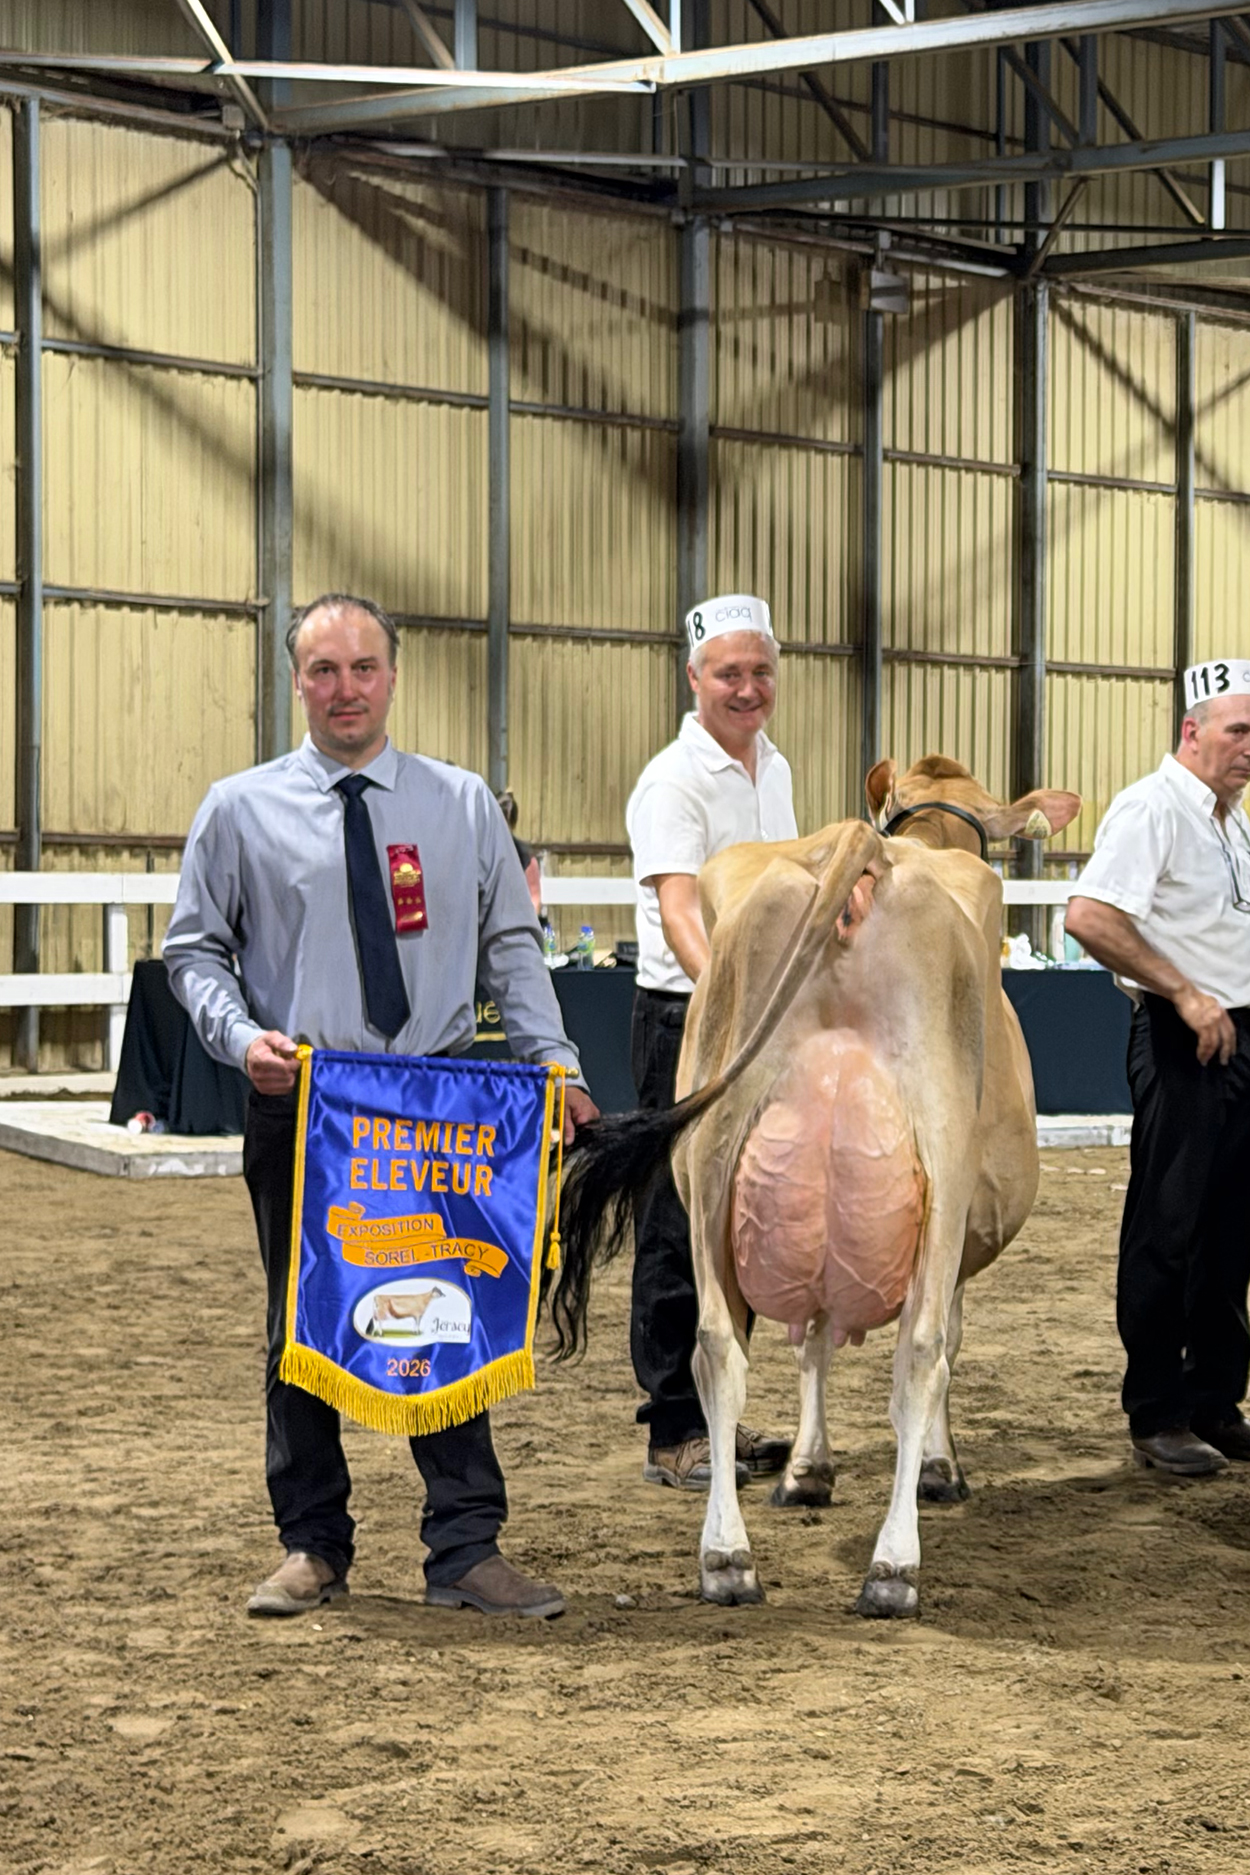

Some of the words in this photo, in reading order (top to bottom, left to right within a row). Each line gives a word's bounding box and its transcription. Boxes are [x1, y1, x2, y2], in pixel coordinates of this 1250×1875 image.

[1191, 663, 1230, 700] 113
[352, 1116, 497, 1157] PREMIER
[350, 1157, 493, 1197] ELEVEUR
[336, 1218, 434, 1238] EXPOSITION
[364, 1249, 419, 1266] SOREL
[386, 1358, 431, 1378] 2026
